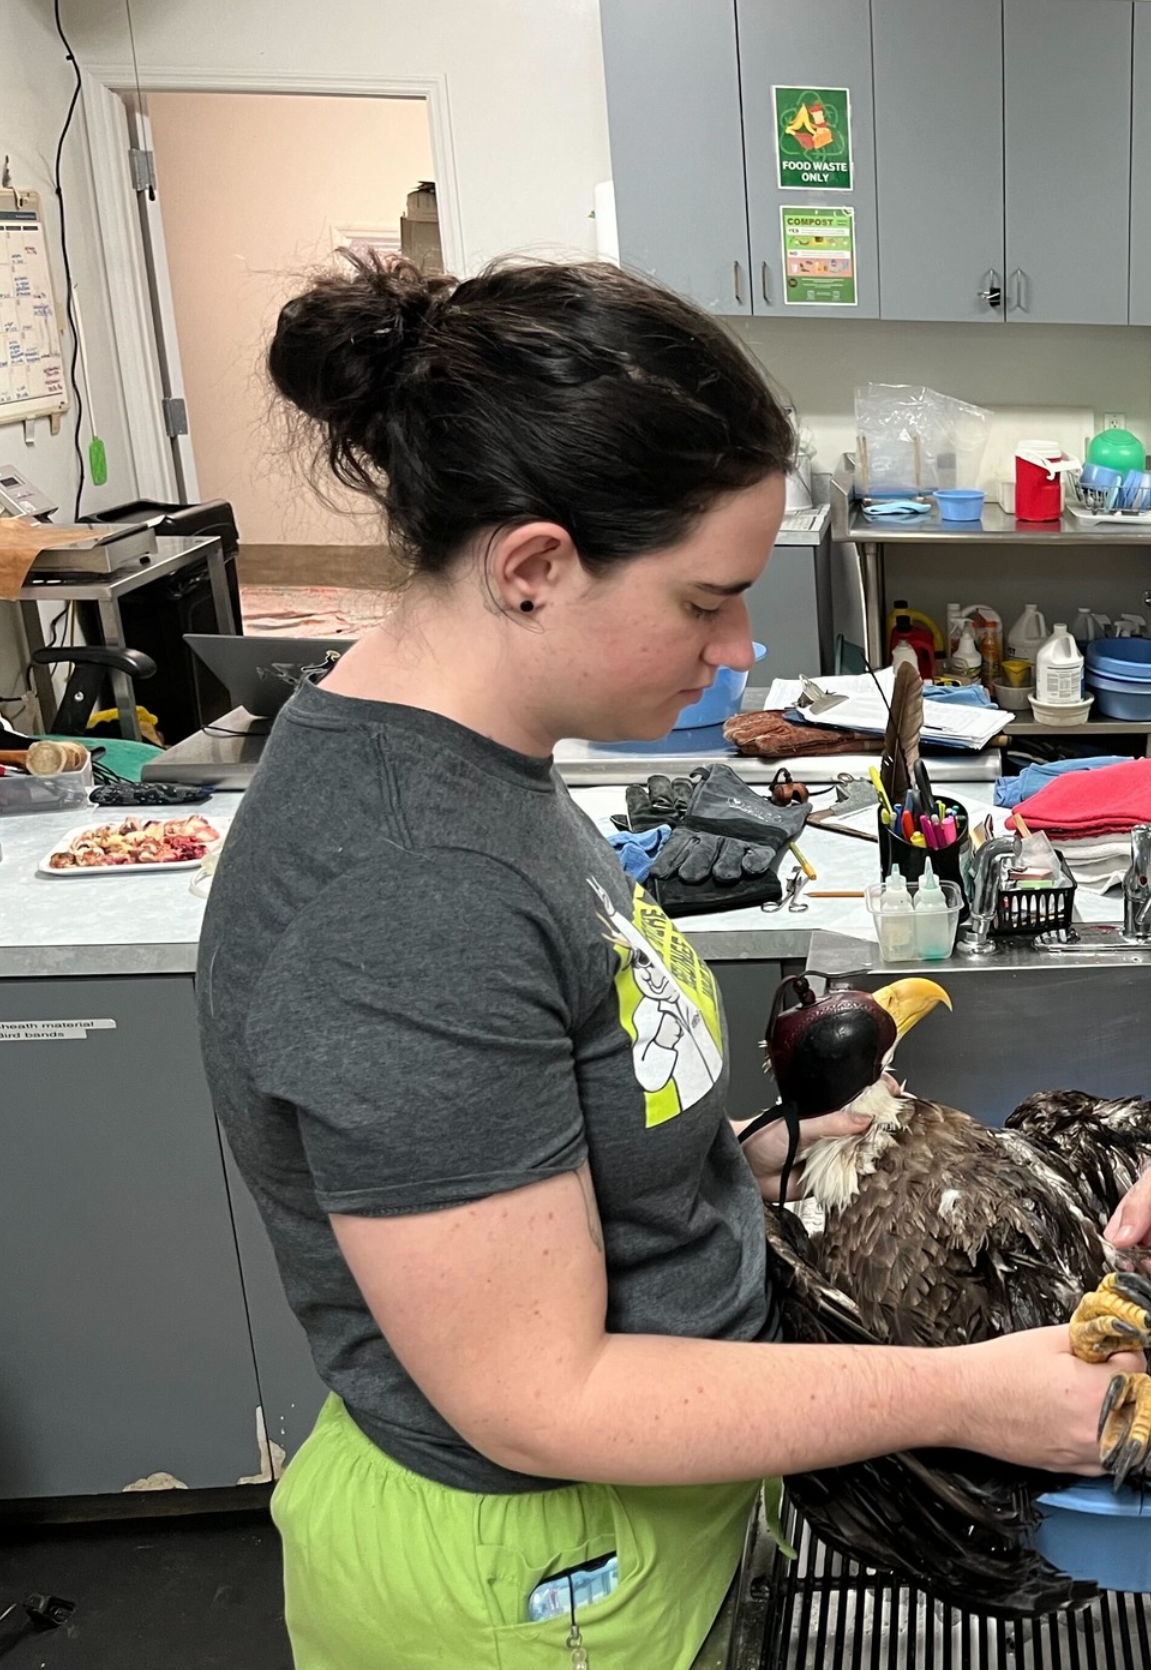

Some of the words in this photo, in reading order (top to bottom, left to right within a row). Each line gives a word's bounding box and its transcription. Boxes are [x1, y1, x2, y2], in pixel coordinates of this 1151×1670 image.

[782, 161, 811, 171] FOOD
[813, 162, 847, 172] WASTE
[801, 173, 829, 182] ONLY
[787, 217, 834, 226] COMPOST
[42, 1021, 94, 1029] material
